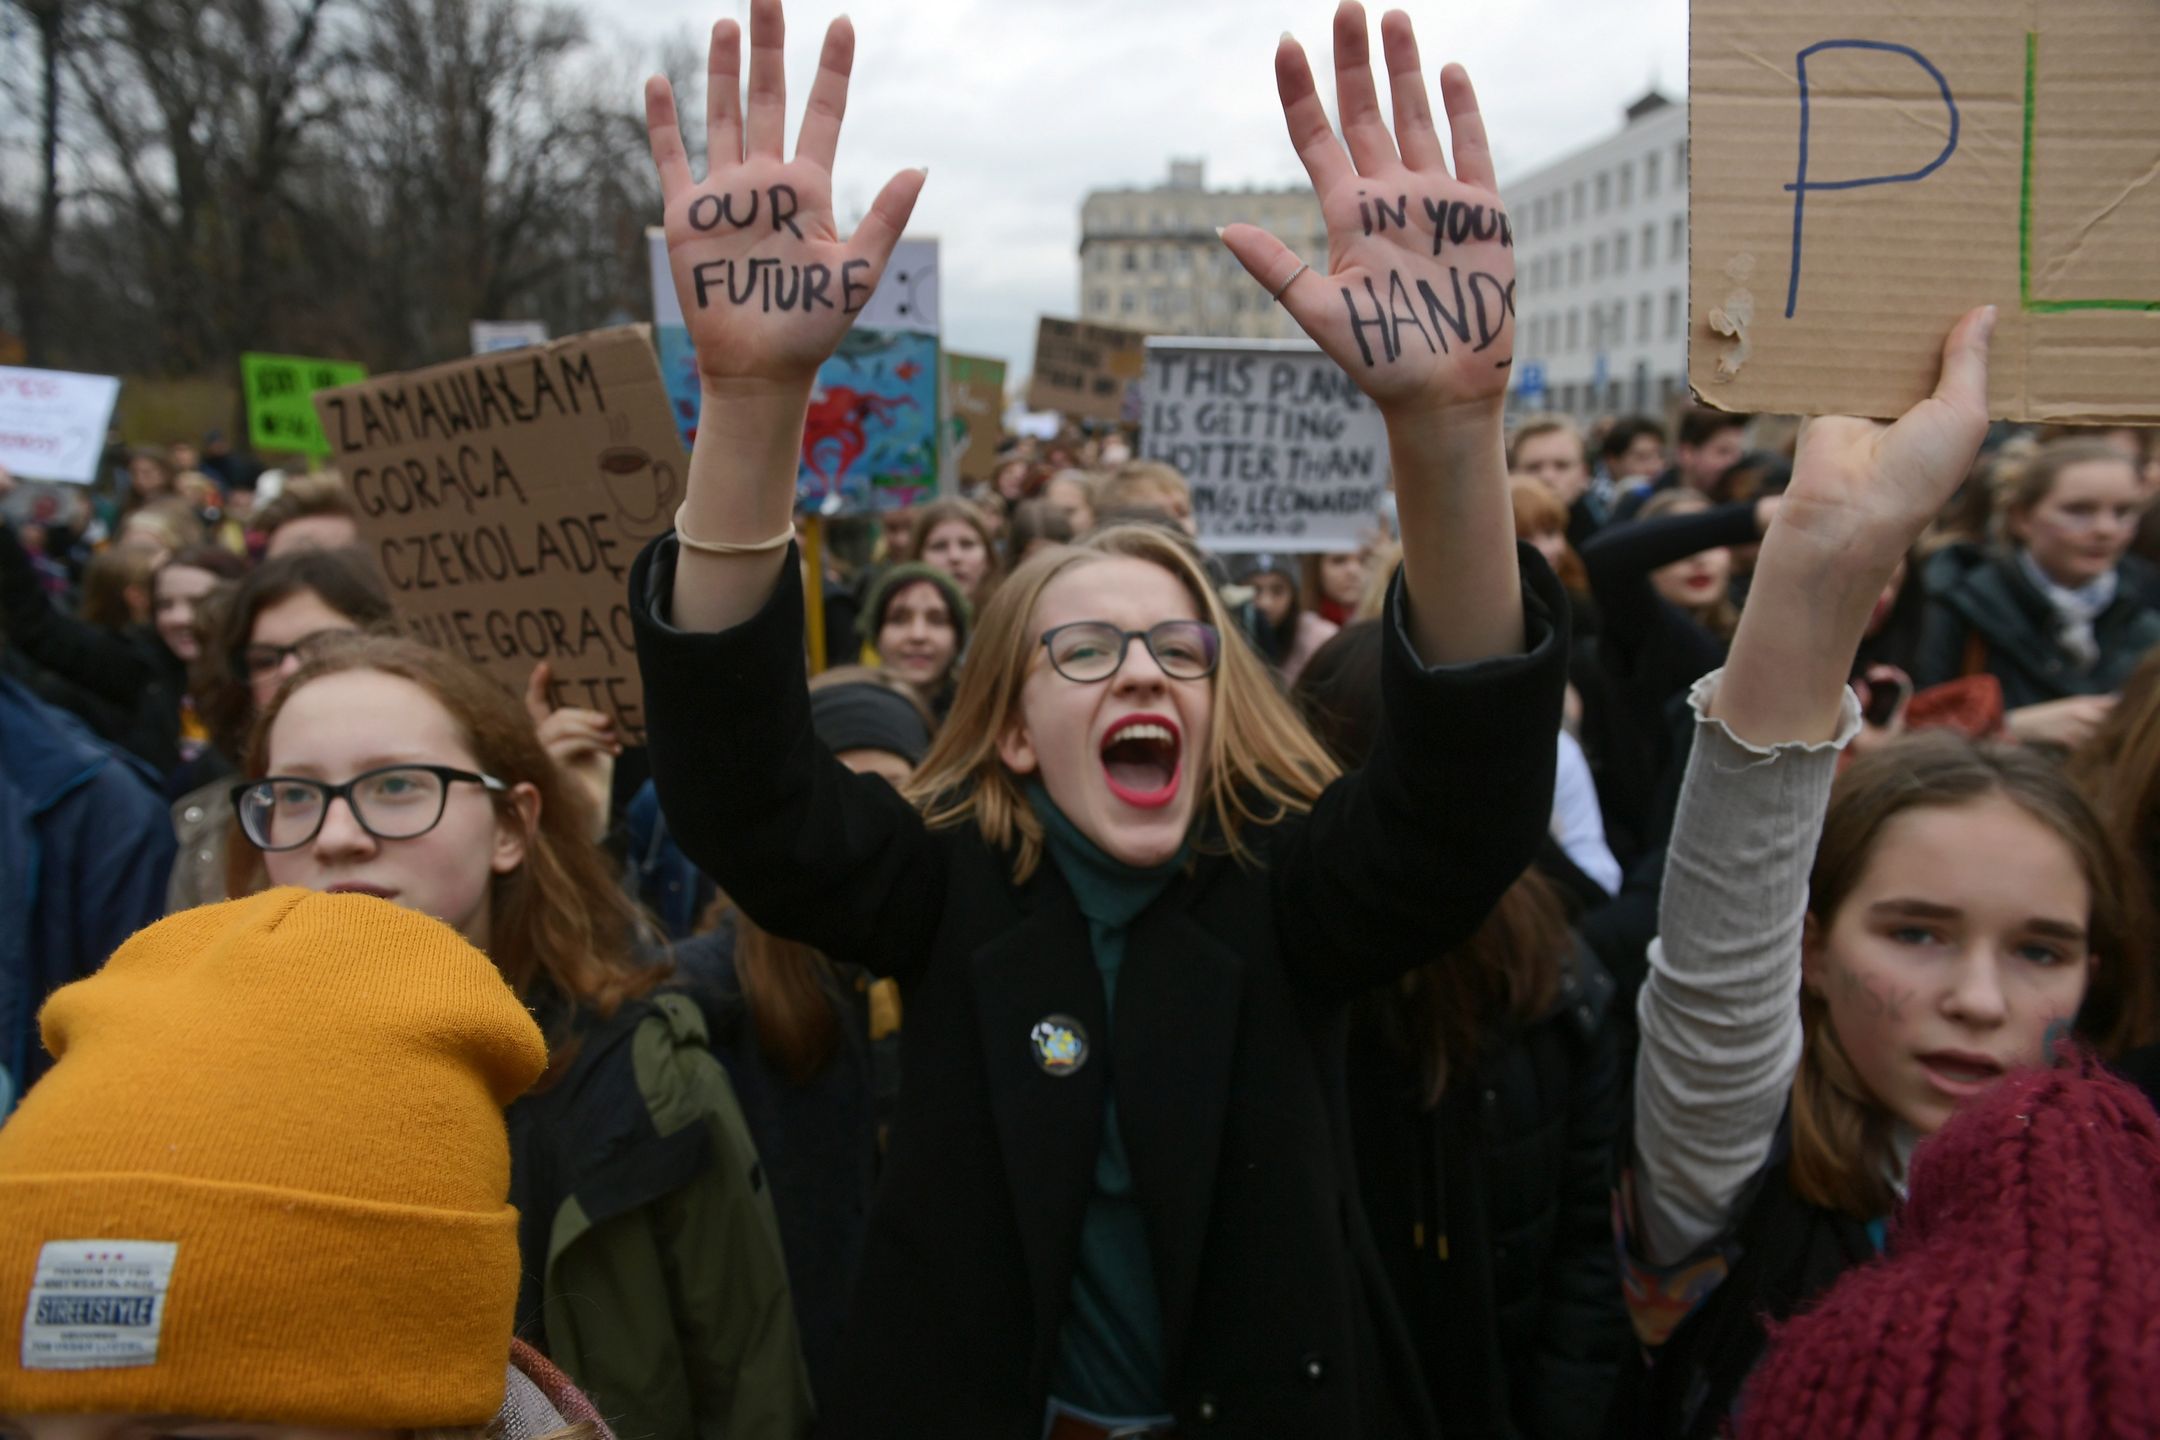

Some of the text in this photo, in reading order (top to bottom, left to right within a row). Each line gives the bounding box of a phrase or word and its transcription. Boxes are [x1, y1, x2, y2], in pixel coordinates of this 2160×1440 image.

[688, 184, 804, 240] OUR
[693, 259, 870, 314] FUTURE
[1152, 352, 1257, 398] THIS
[327, 353, 605, 453] ZAMAWIAŁAM
[1152, 401, 1348, 441] IS GETTING
[1148, 440, 1381, 482] HOTTER THAN
[380, 513, 626, 591] CZEKOLADĘ
